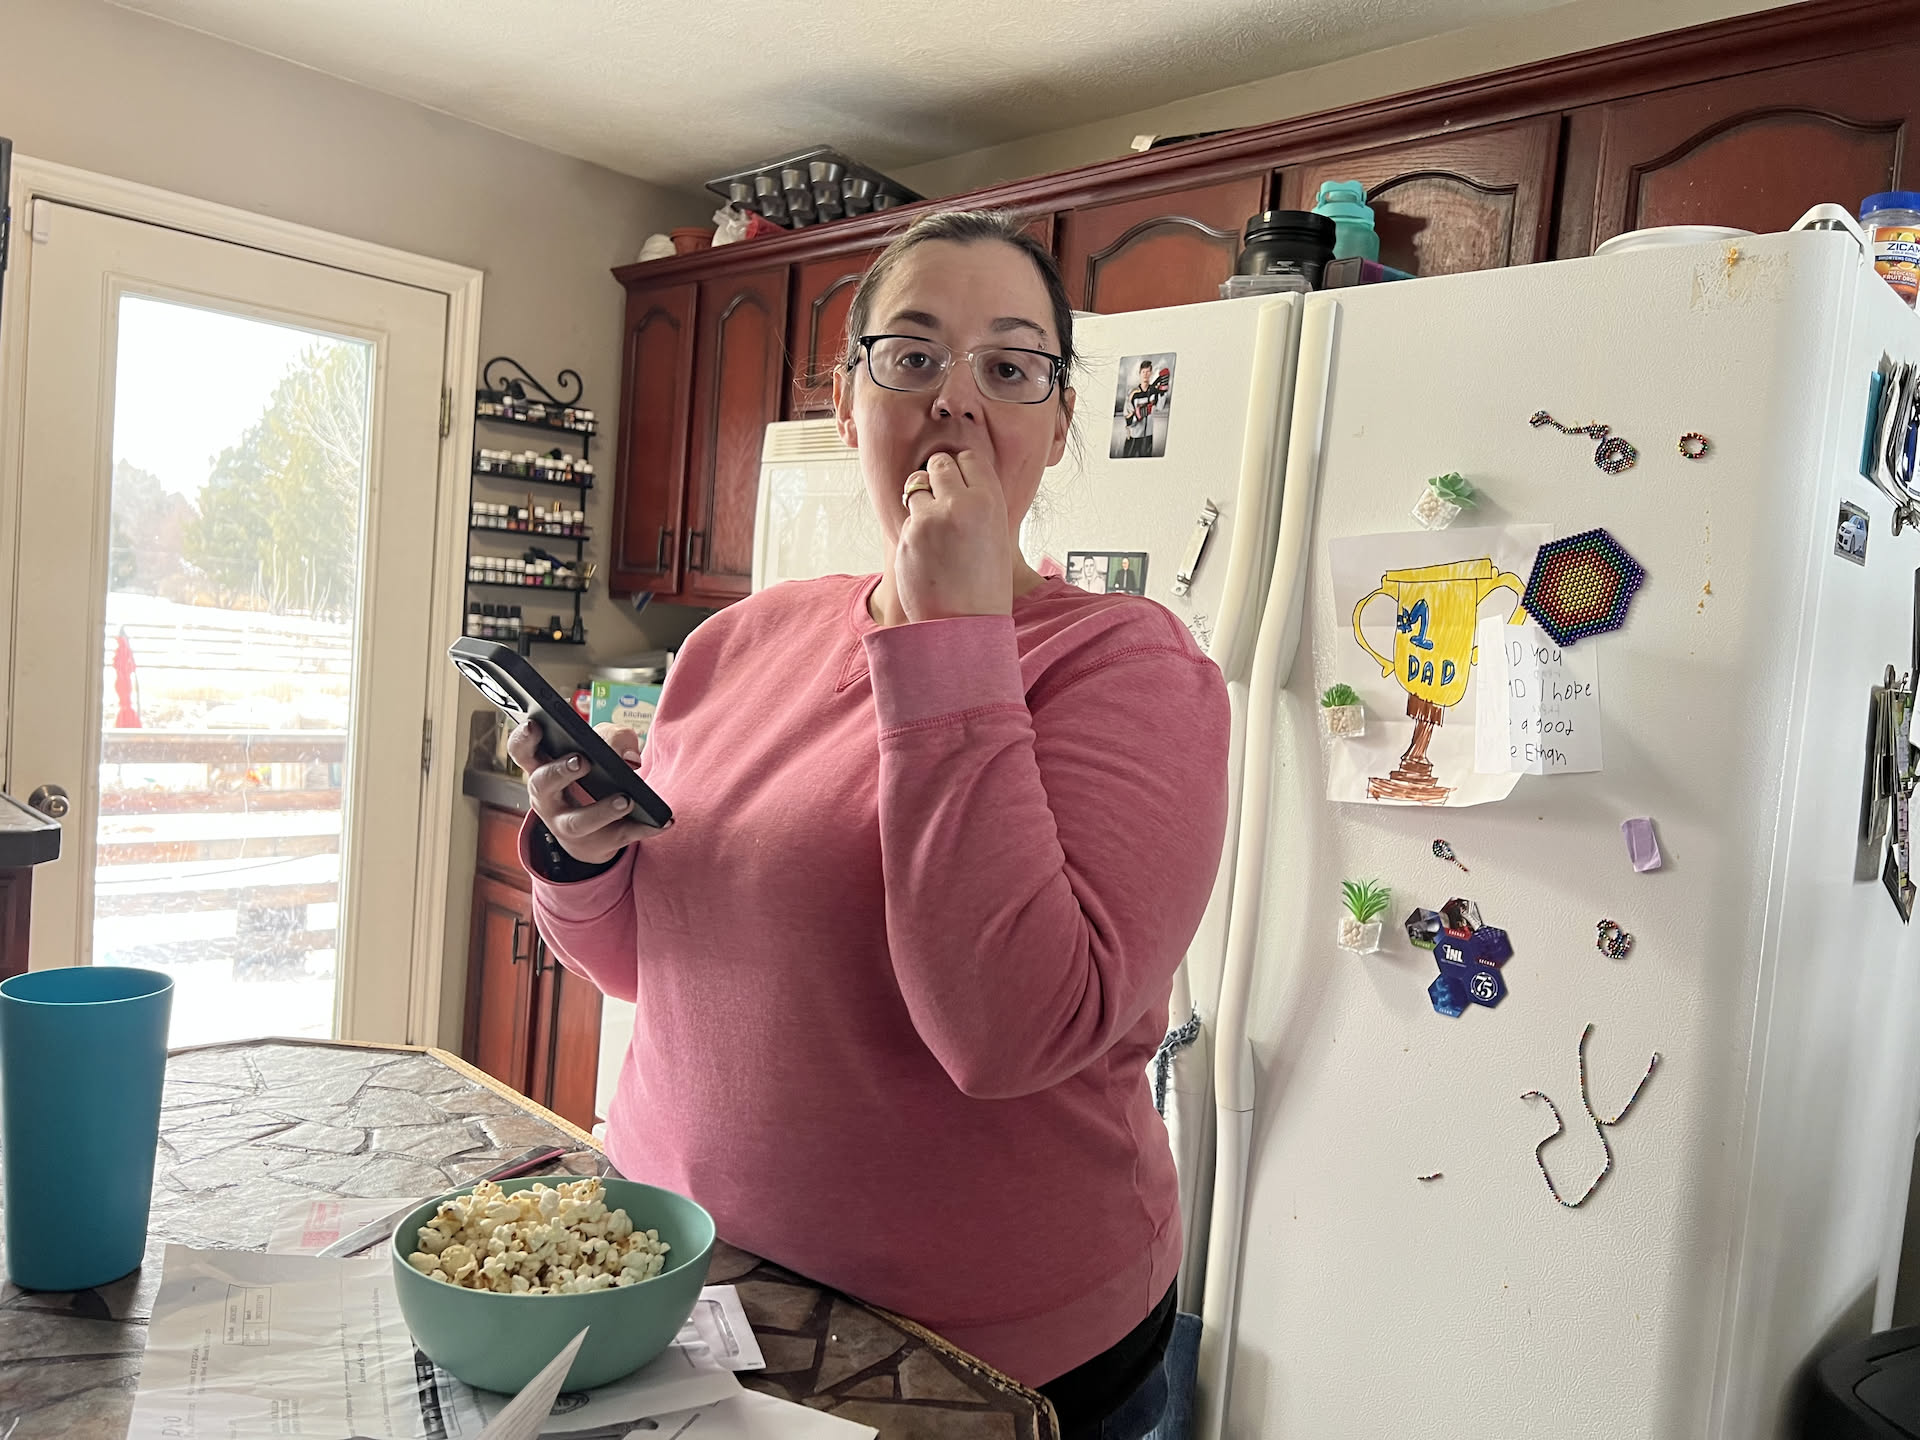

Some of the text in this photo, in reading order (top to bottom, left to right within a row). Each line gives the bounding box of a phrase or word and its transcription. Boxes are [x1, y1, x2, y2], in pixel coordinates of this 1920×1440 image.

[1407, 655, 1456, 686] DAD
[596, 686, 607, 697] 13
[1552, 681, 1593, 702] hope
[623, 709, 653, 719] Kitchen
[1525, 743, 1568, 766] Ethan
[1478, 958, 1496, 967] SECURE
[1475, 975, 1493, 998] 75
